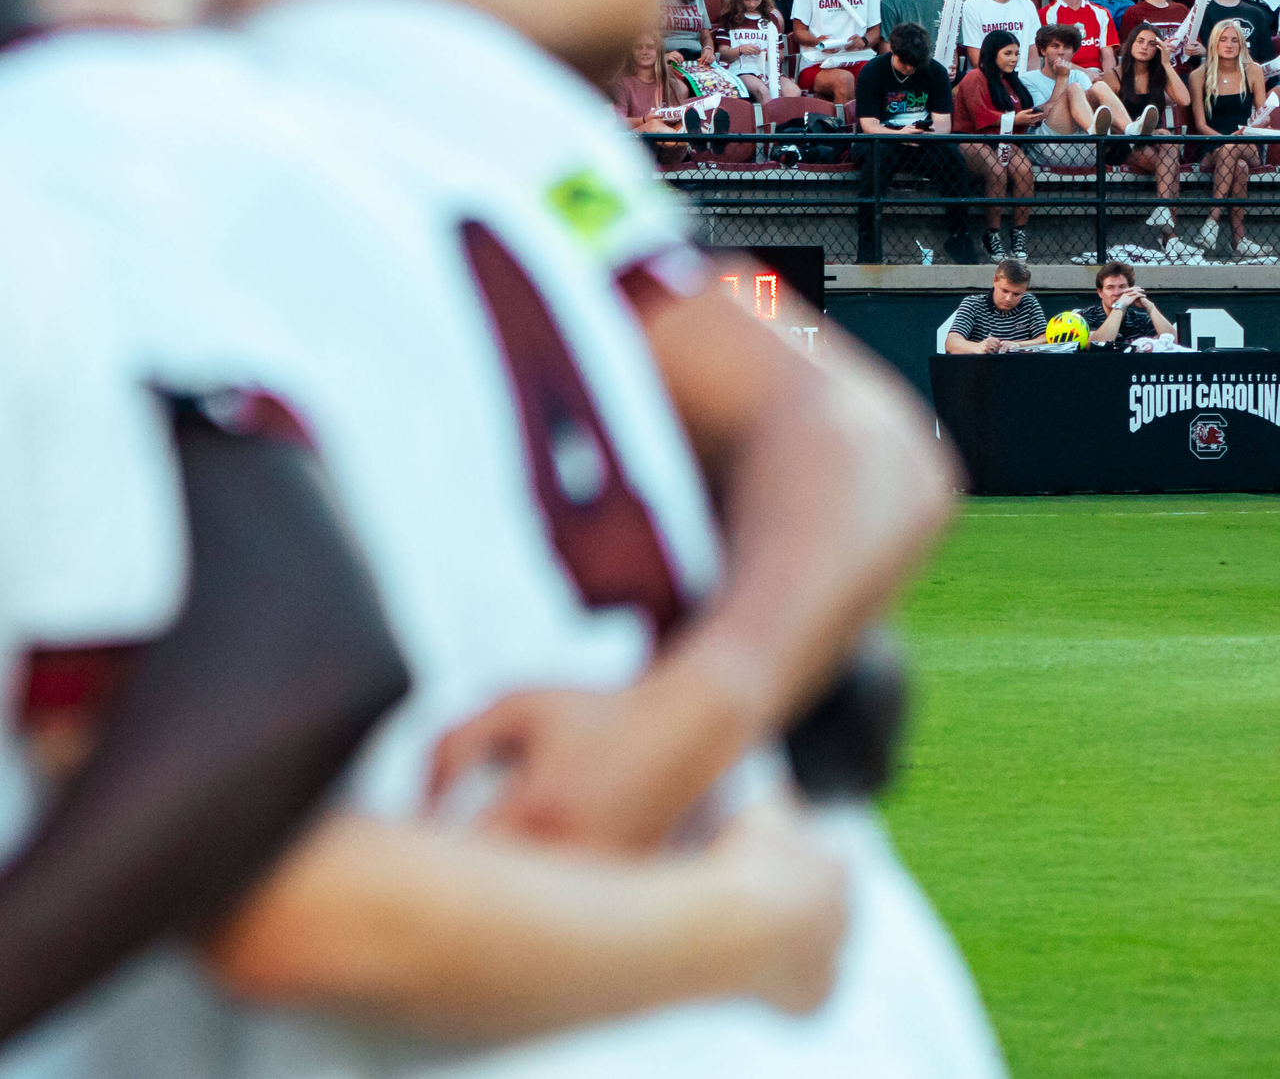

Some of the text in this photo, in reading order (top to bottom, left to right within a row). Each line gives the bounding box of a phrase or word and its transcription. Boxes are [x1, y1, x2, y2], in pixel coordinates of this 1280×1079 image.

[734, 32, 767, 41] CAROLIN
[1132, 374, 1202, 382] GAMECOCK
[1129, 384, 1192, 433] SOUTH
